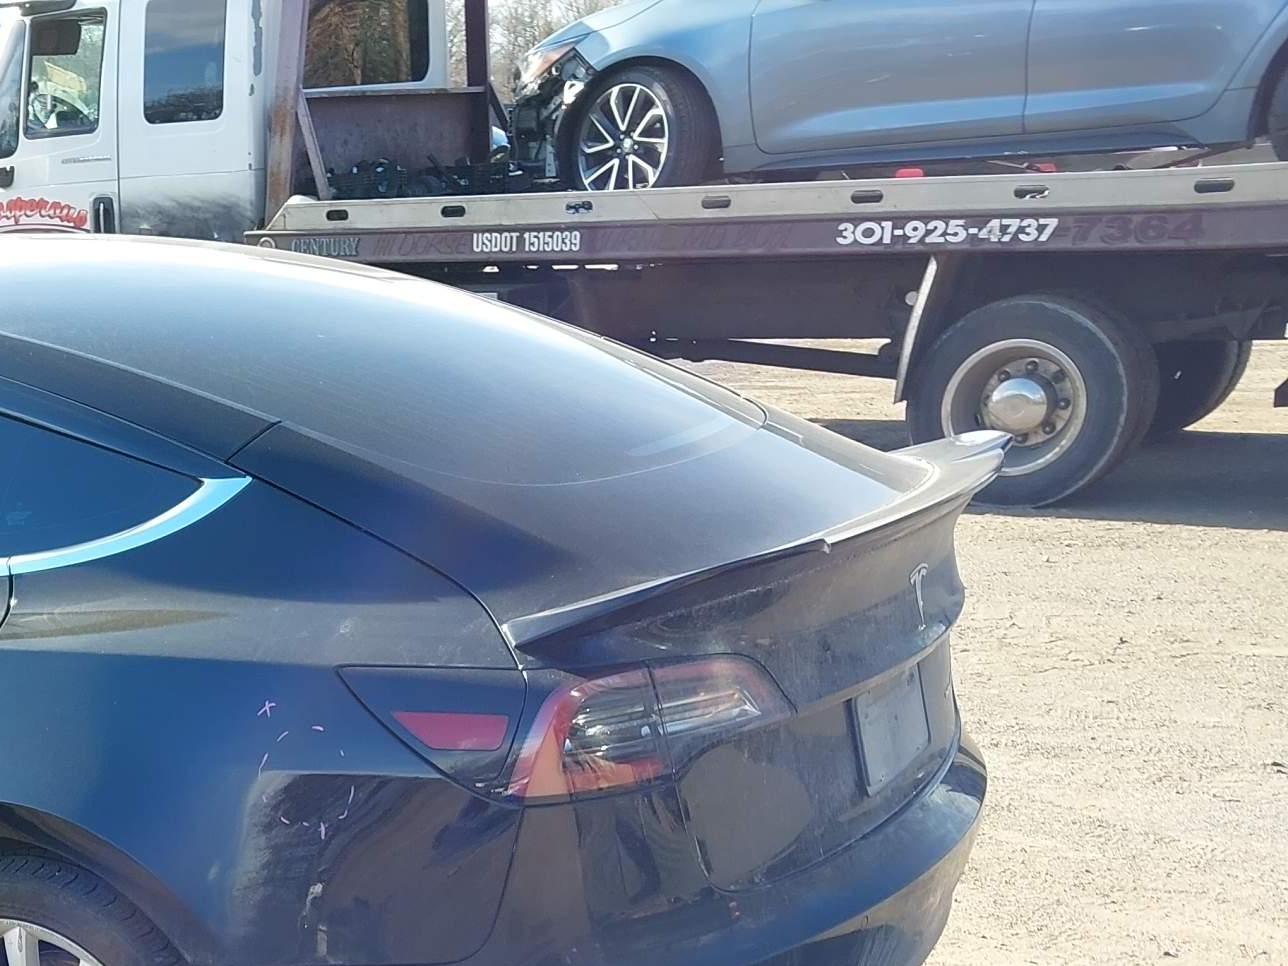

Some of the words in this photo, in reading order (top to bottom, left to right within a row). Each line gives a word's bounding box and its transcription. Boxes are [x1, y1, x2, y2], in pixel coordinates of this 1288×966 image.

[472, 232, 520, 253] USDOT
[523, 230, 581, 252] 1515039
[836, 218, 1059, 245] 301-925-4737
[291, 237, 360, 256] CENTURY
